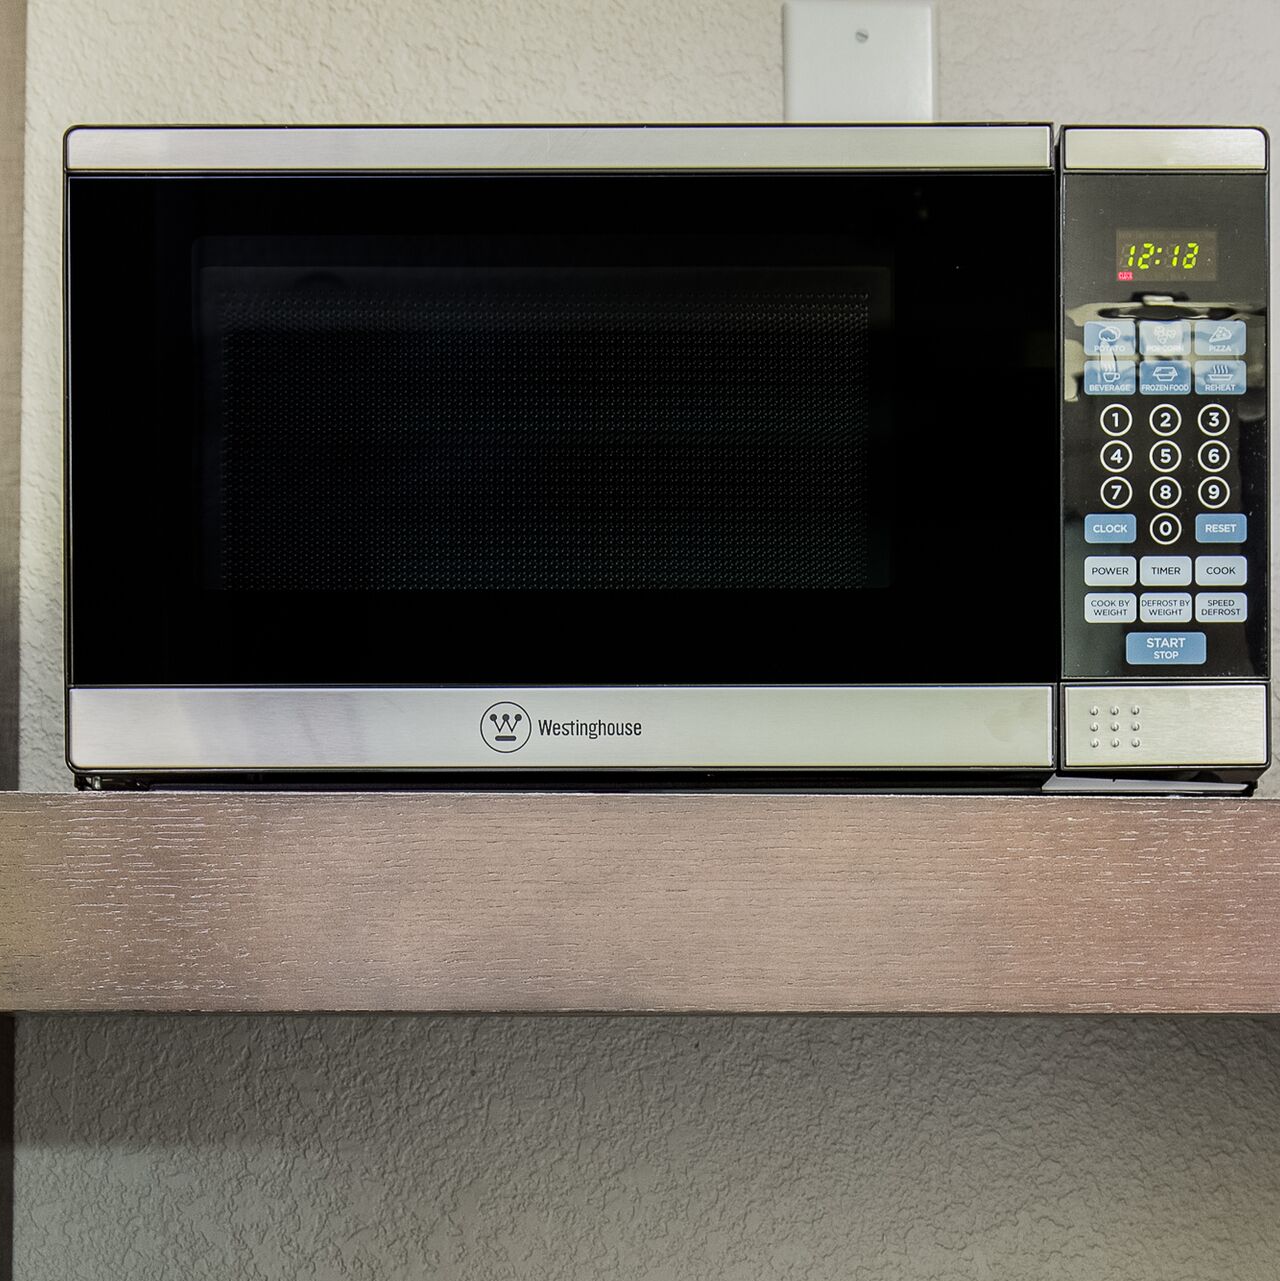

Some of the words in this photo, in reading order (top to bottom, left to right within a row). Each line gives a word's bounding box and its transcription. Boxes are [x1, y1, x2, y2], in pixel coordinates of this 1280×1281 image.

[1089, 384, 1131, 392] BEVERAGE
[1141, 384, 1168, 392] FROZEN
[1170, 384, 1189, 392] FOOD
[1205, 384, 1236, 392] REHEAT
[1092, 524, 1128, 534] CLOCK
[1205, 524, 1237, 534] RESET
[1091, 566, 1129, 576] POWER
[1151, 566, 1181, 576] TIMER
[1206, 566, 1236, 576] COOK
[1090, 599, 1116, 608] COOK
[1118, 599, 1131, 608] BY
[1141, 599, 1176, 608] DEFROST
[1178, 599, 1191, 608] BY
[1207, 599, 1236, 608] SPEED
[1093, 608, 1128, 617] WEIGHT
[1149, 608, 1183, 617] WEIGHT
[1201, 607, 1241, 616] DEFROST
[1146, 637, 1186, 649] START
[1153, 651, 1179, 660] STOP
[538, 719, 642, 740] Westinghouse
